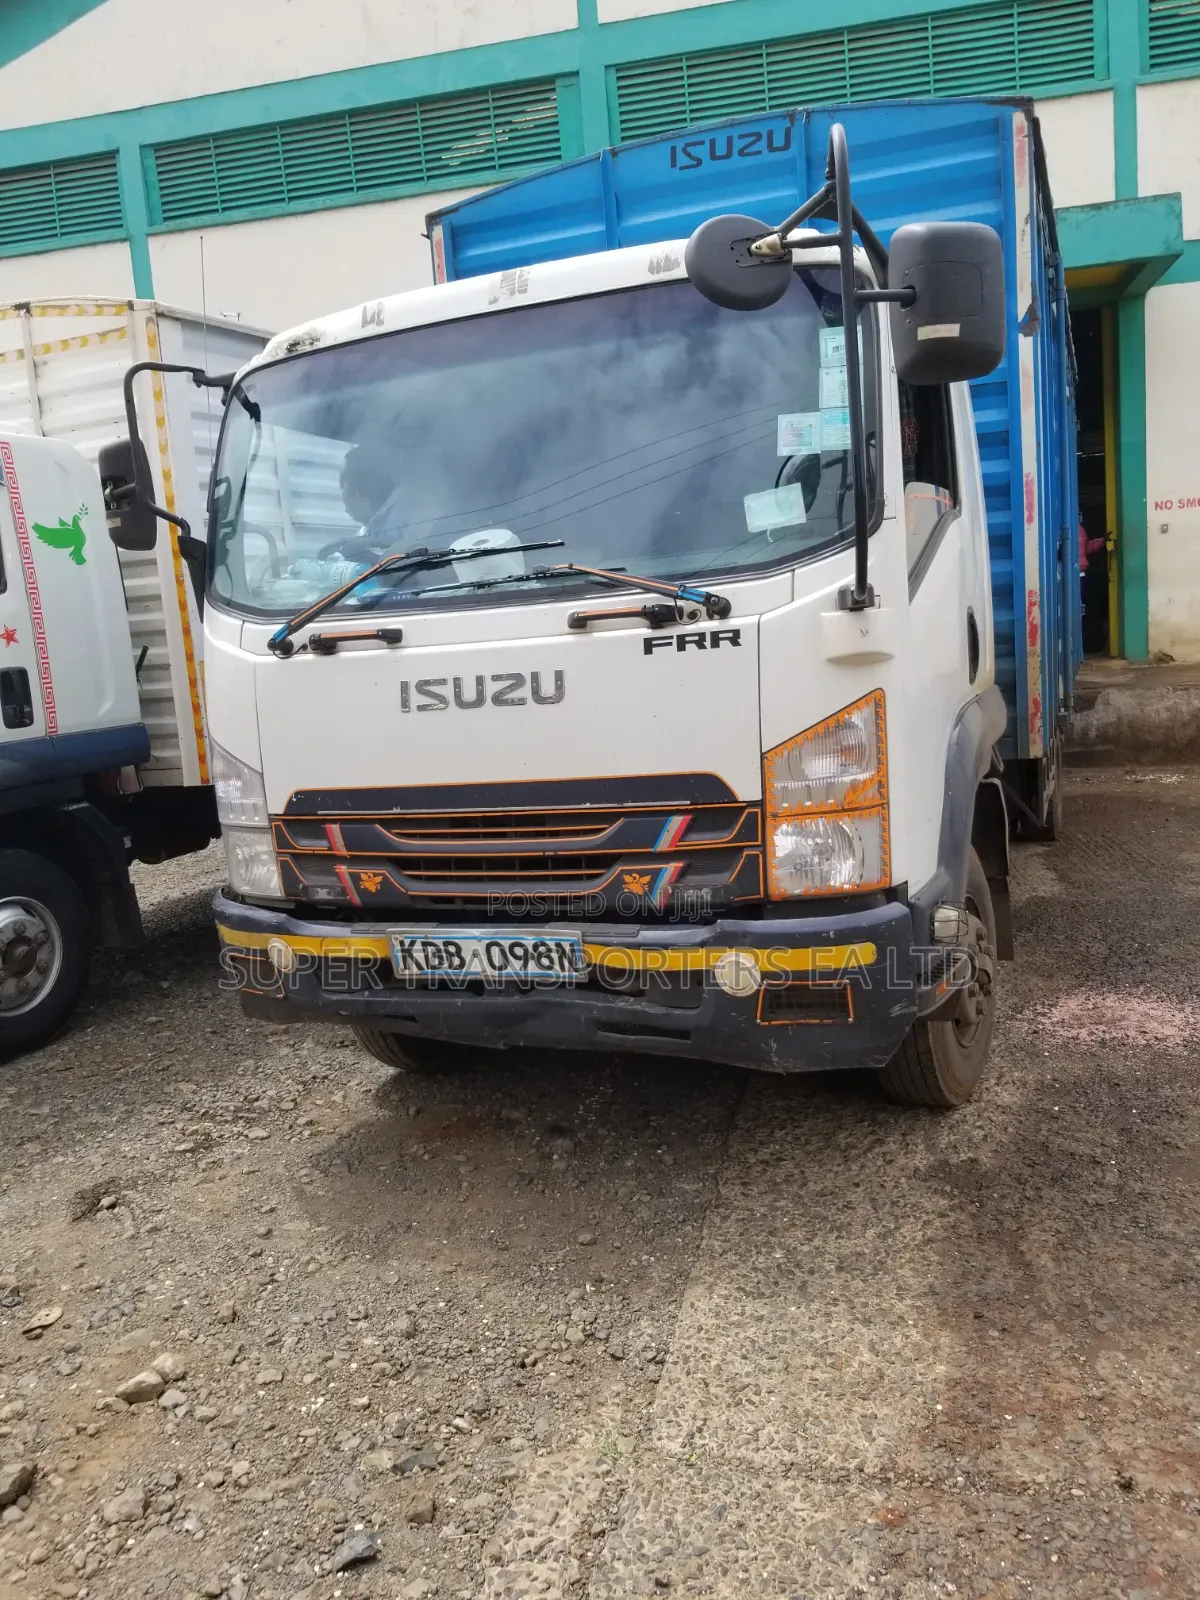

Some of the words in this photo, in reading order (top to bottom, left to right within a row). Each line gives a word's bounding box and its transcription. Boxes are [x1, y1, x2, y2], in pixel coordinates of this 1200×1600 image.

[670, 126, 791, 171] ISUZU
[1154, 499, 1174, 511] NO
[643, 628, 742, 655] FRR
[400, 669, 566, 713] ISUZU
